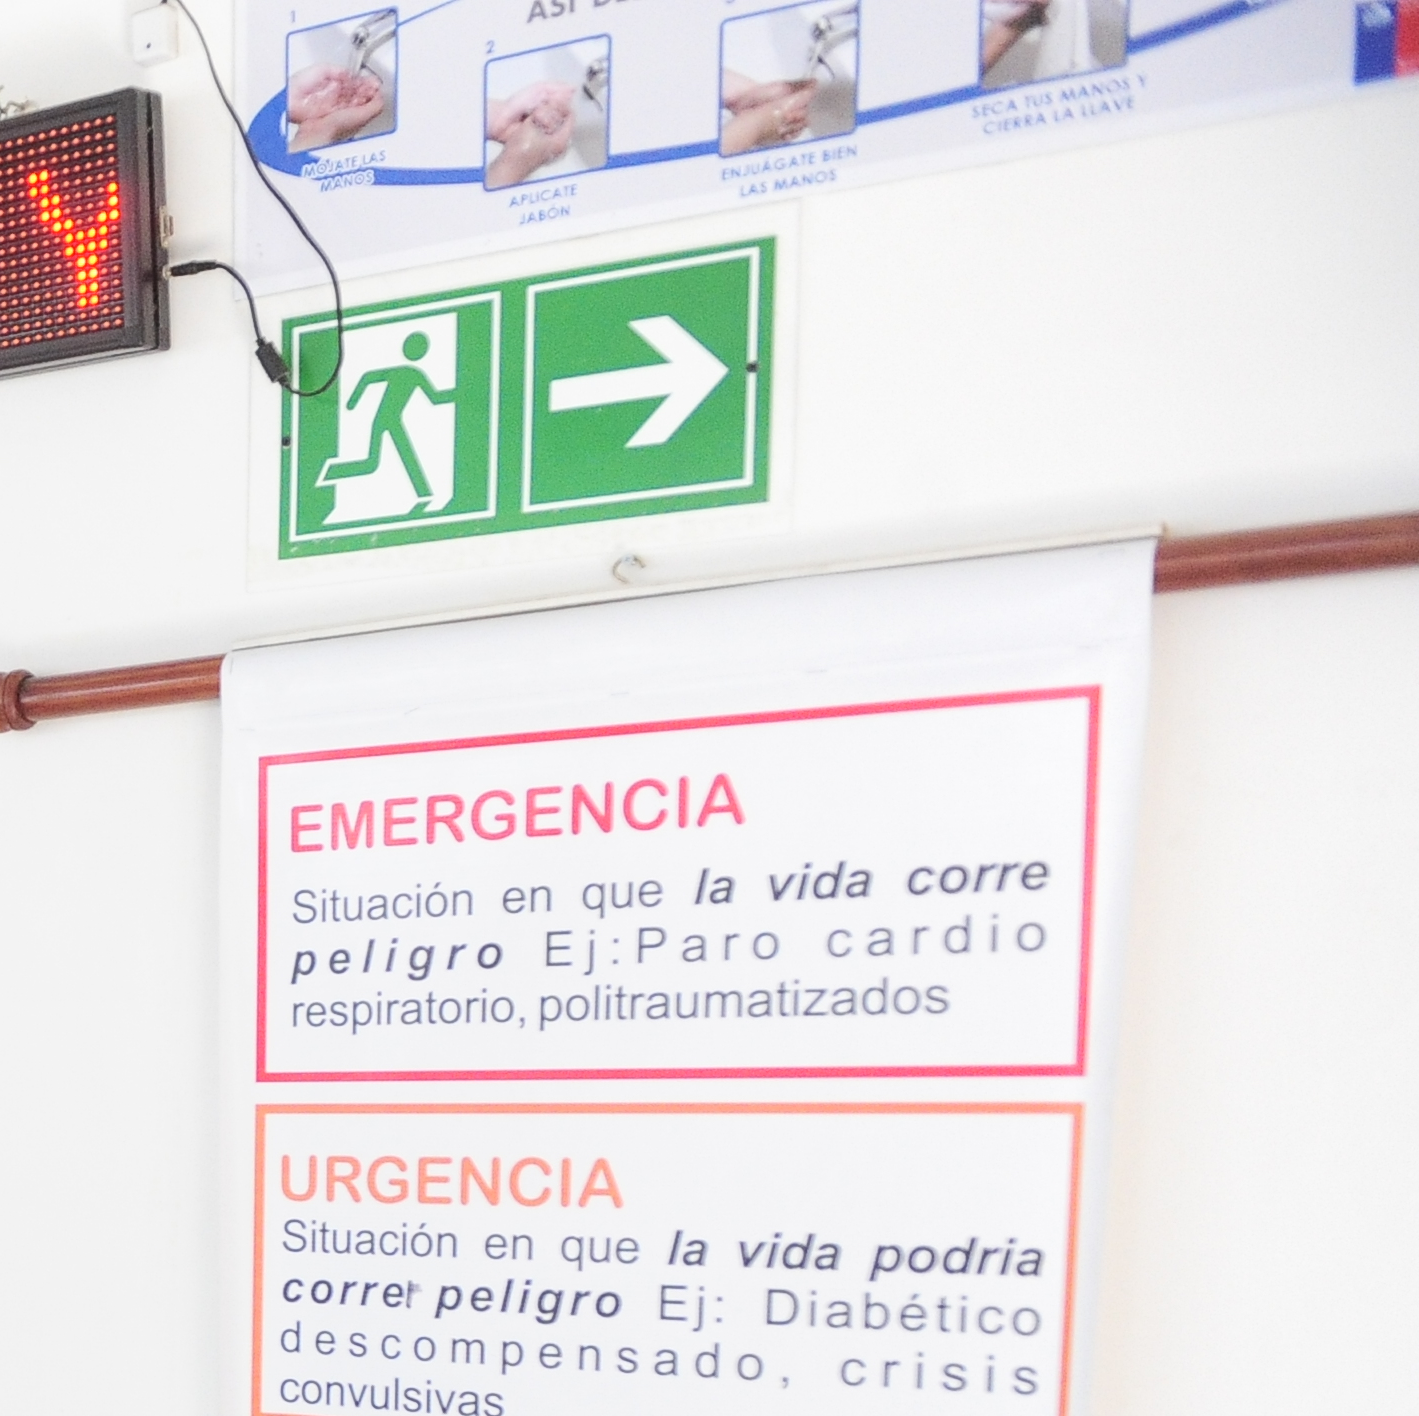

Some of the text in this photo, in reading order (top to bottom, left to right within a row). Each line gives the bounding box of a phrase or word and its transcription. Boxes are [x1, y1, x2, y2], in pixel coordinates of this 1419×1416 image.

[486, 41, 495, 54] 2
[971, 74, 1149, 120] SECA TUS MANOS Y
[982, 96, 1135, 135] CIERRA LA LLAVE
[321, 172, 373, 192] MANOS
[363, 150, 386, 164] LAS
[721, 144, 858, 182] ENJUÁGATE BIEN
[739, 168, 837, 197] LAS MANOS
[25, 168, 122, 309] Y
[520, 203, 570, 224] JABÓN
[288, 772, 746, 855] EMERGENCIA
[291, 856, 1051, 924] Situación en que la vida corre
[290, 936, 505, 983] peligro
[825, 913, 1047, 958] cardio
[290, 975, 950, 1034] respiratorio, politraumatizados
[279, 1154, 624, 1209] URGENCIA
[281, 1218, 1044, 1281] Situación en que la vida podria
[435, 1281, 623, 1325] peligro
[657, 1284, 726, 1331] Ej:
[765, 1287, 1043, 1337] Diabético
[279, 1322, 1040, 1396] descompensado, crisis
